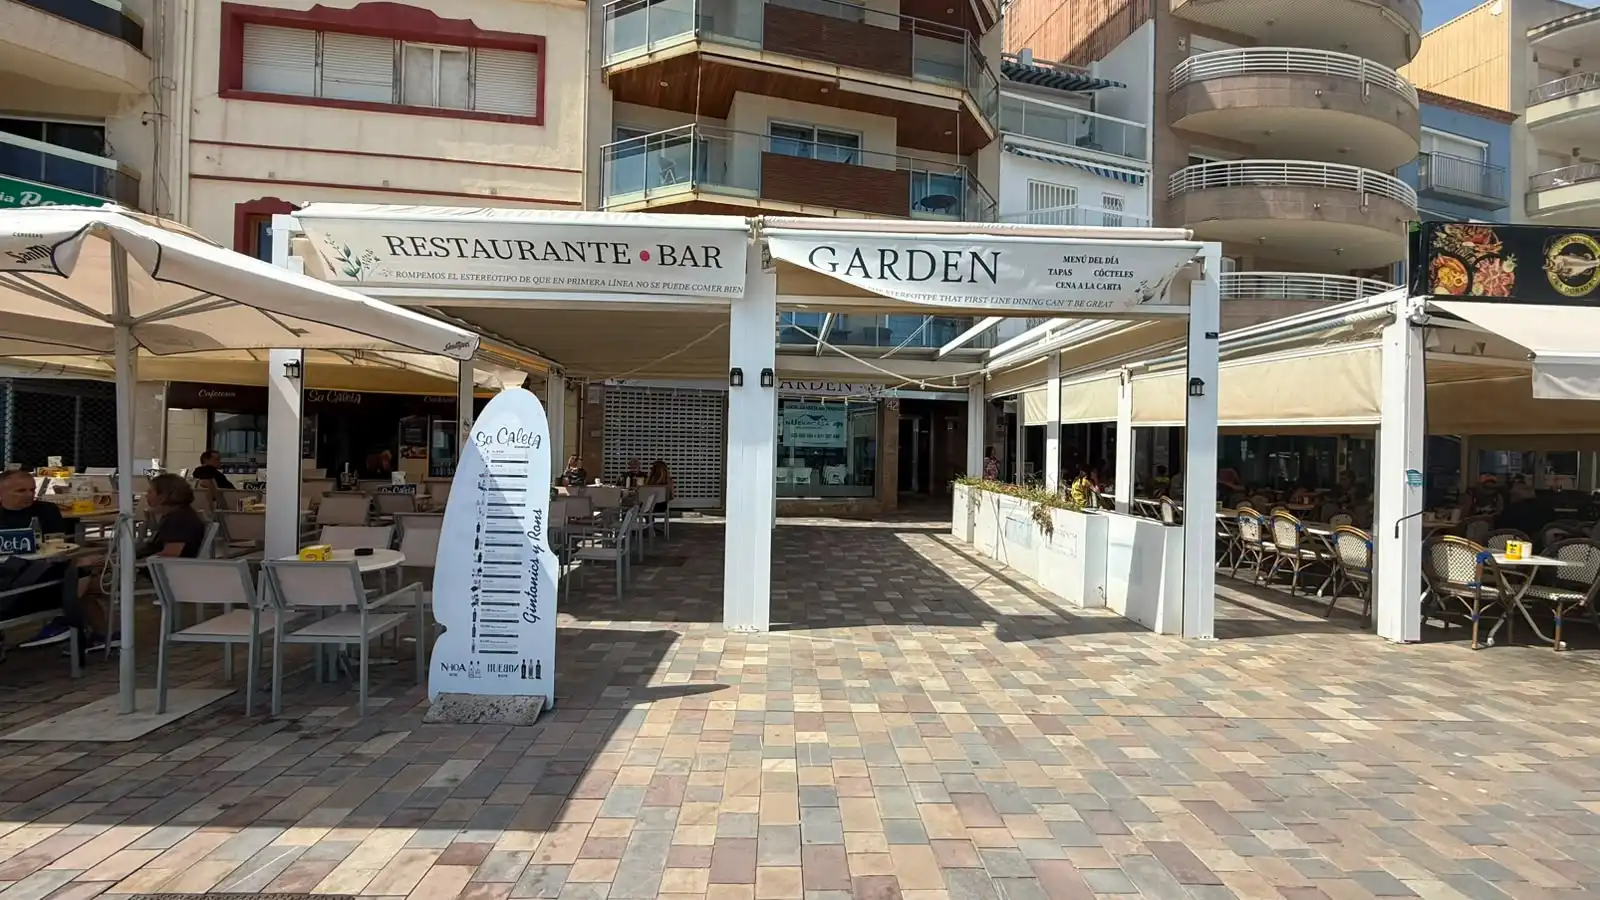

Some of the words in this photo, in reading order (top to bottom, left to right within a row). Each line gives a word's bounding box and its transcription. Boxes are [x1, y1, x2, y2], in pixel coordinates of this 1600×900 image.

[382, 235, 632, 265] RESTAURANTE
[656, 244, 723, 269] BAR
[1063, 254, 1087, 264] MENÚ
[1088, 256, 1104, 265] DEL
[1105, 255, 1119, 265] DÍA
[808, 245, 1002, 285] GARDEN
[1048, 268, 1073, 277] TAPAS
[1093, 268, 1134, 278] CÓCTELES
[395, 271, 446, 280] ROMPEMOS
[447, 272, 459, 281] EL
[460, 273, 518, 283] ESTEREOTIPO
[519, 275, 531, 284] DE
[532, 276, 551, 285] QUE
[552, 277, 565, 285] EN
[566, 278, 606, 287] PRIMERA
[607, 278, 634, 288] LÍNEA
[635, 281, 650, 289] NO
[650, 281, 661, 289] SE
[662, 281, 690, 290] PUEDE
[691, 284, 722, 293] COMER
[723, 285, 743, 294] BIEN
[1055, 281, 1076, 290] CENA
[1077, 282, 1084, 290] A
[1085, 282, 1095, 290] LA
[1096, 283, 1122, 291] CARTA
[939, 294, 962, 303] THAT
[964, 295, 1011, 305] FIRST-LINE
[1011, 297, 1045, 307] DINING
[1074, 300, 1085, 308] BE
[1085, 300, 1114, 308] GREAT
[475, 431, 493, 447] Sa
[527, 508, 543, 541] Rons
[522, 557, 541, 624] Gintonics
